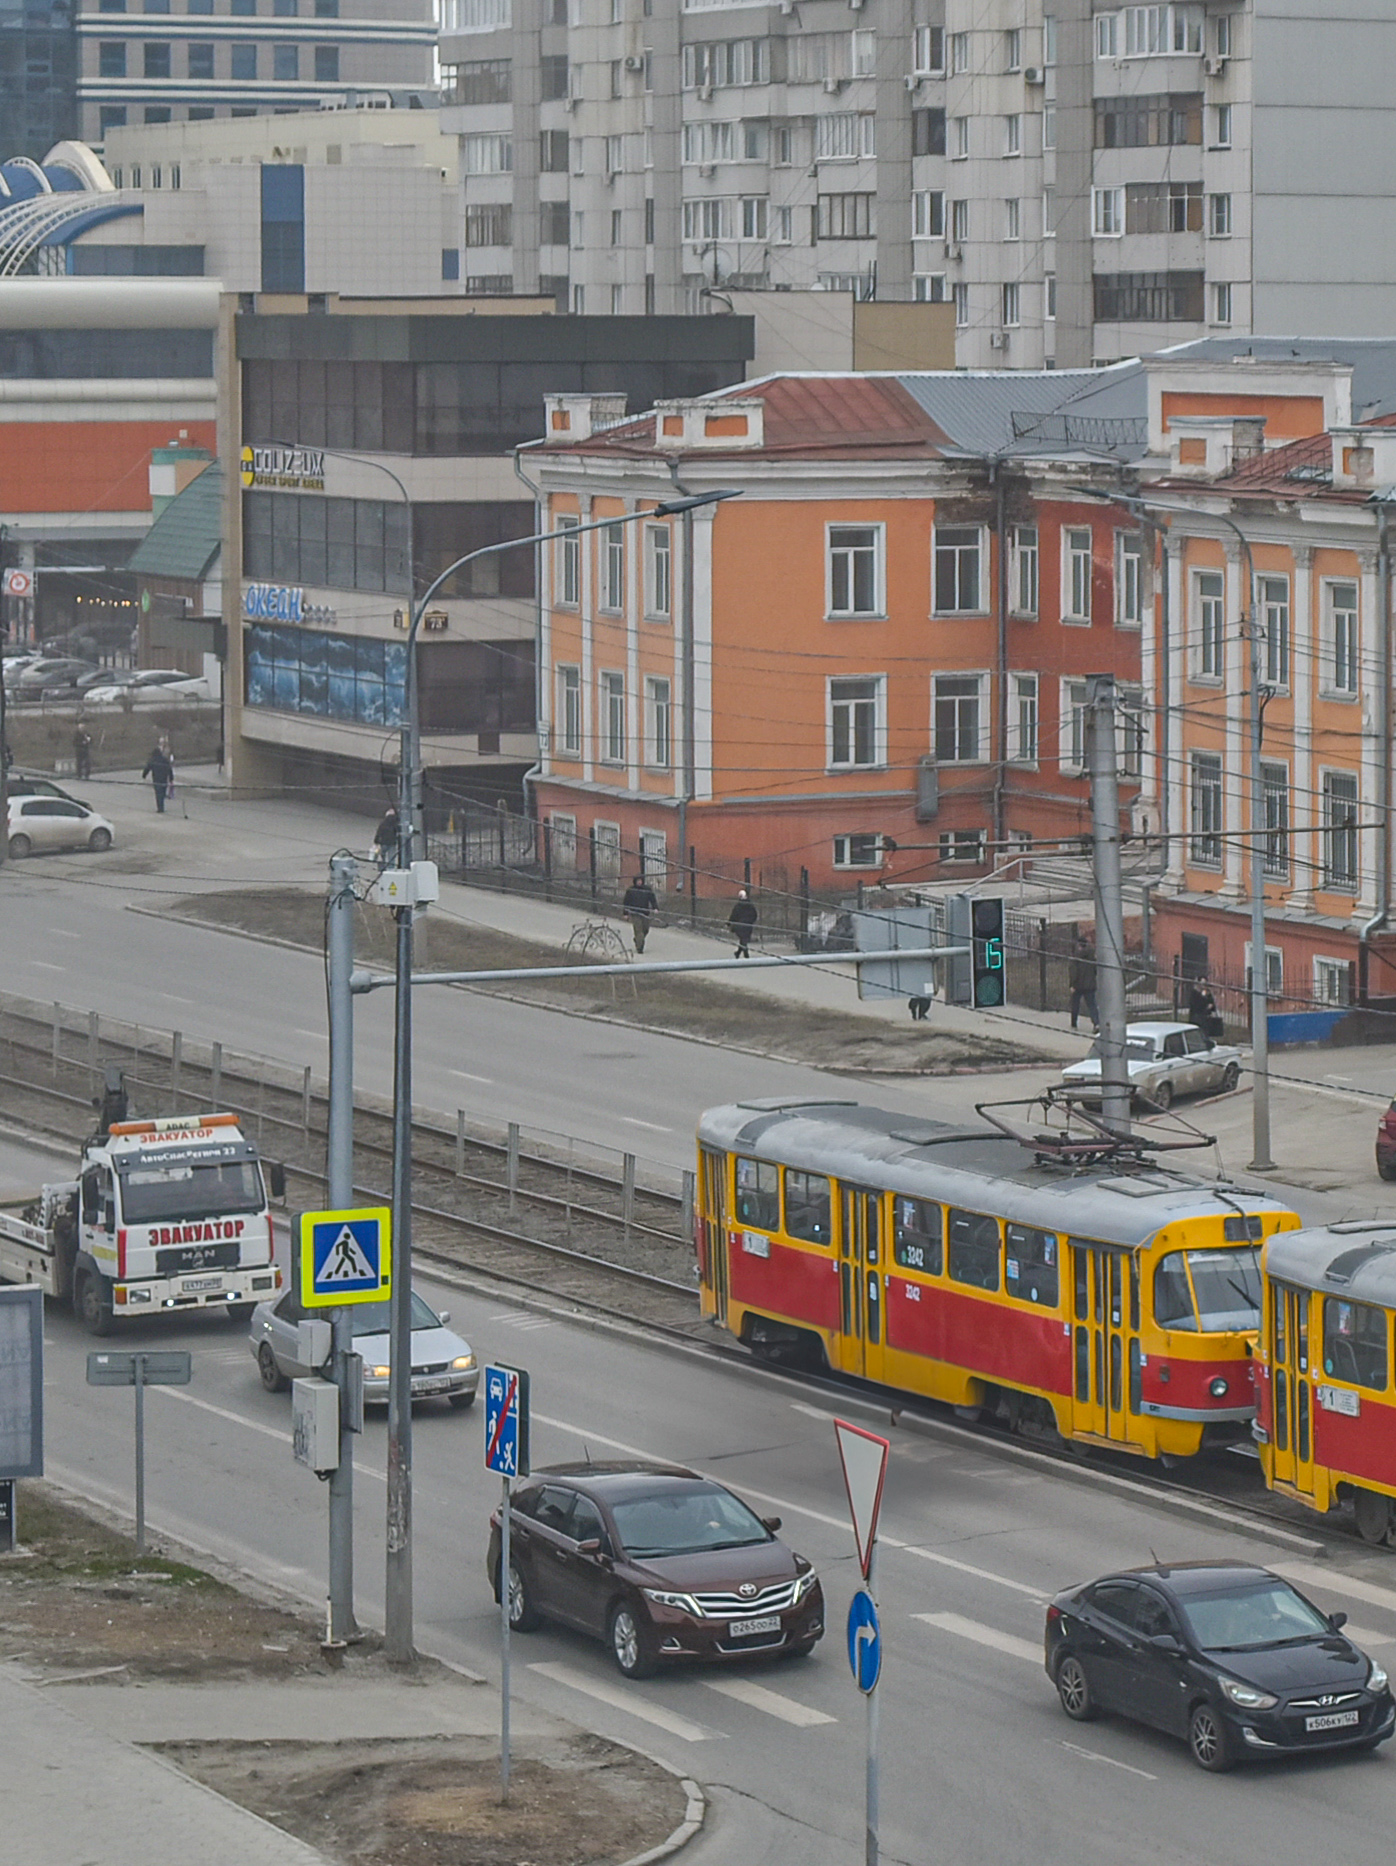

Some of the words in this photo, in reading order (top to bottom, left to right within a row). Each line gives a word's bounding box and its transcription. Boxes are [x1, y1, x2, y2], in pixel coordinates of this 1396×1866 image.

[140, 1129, 214, 1143] ЭВАКУАТОР
[148, 1220, 244, 1246] ЭВАКУАТОР
[182, 1250, 216, 1260] MAN
